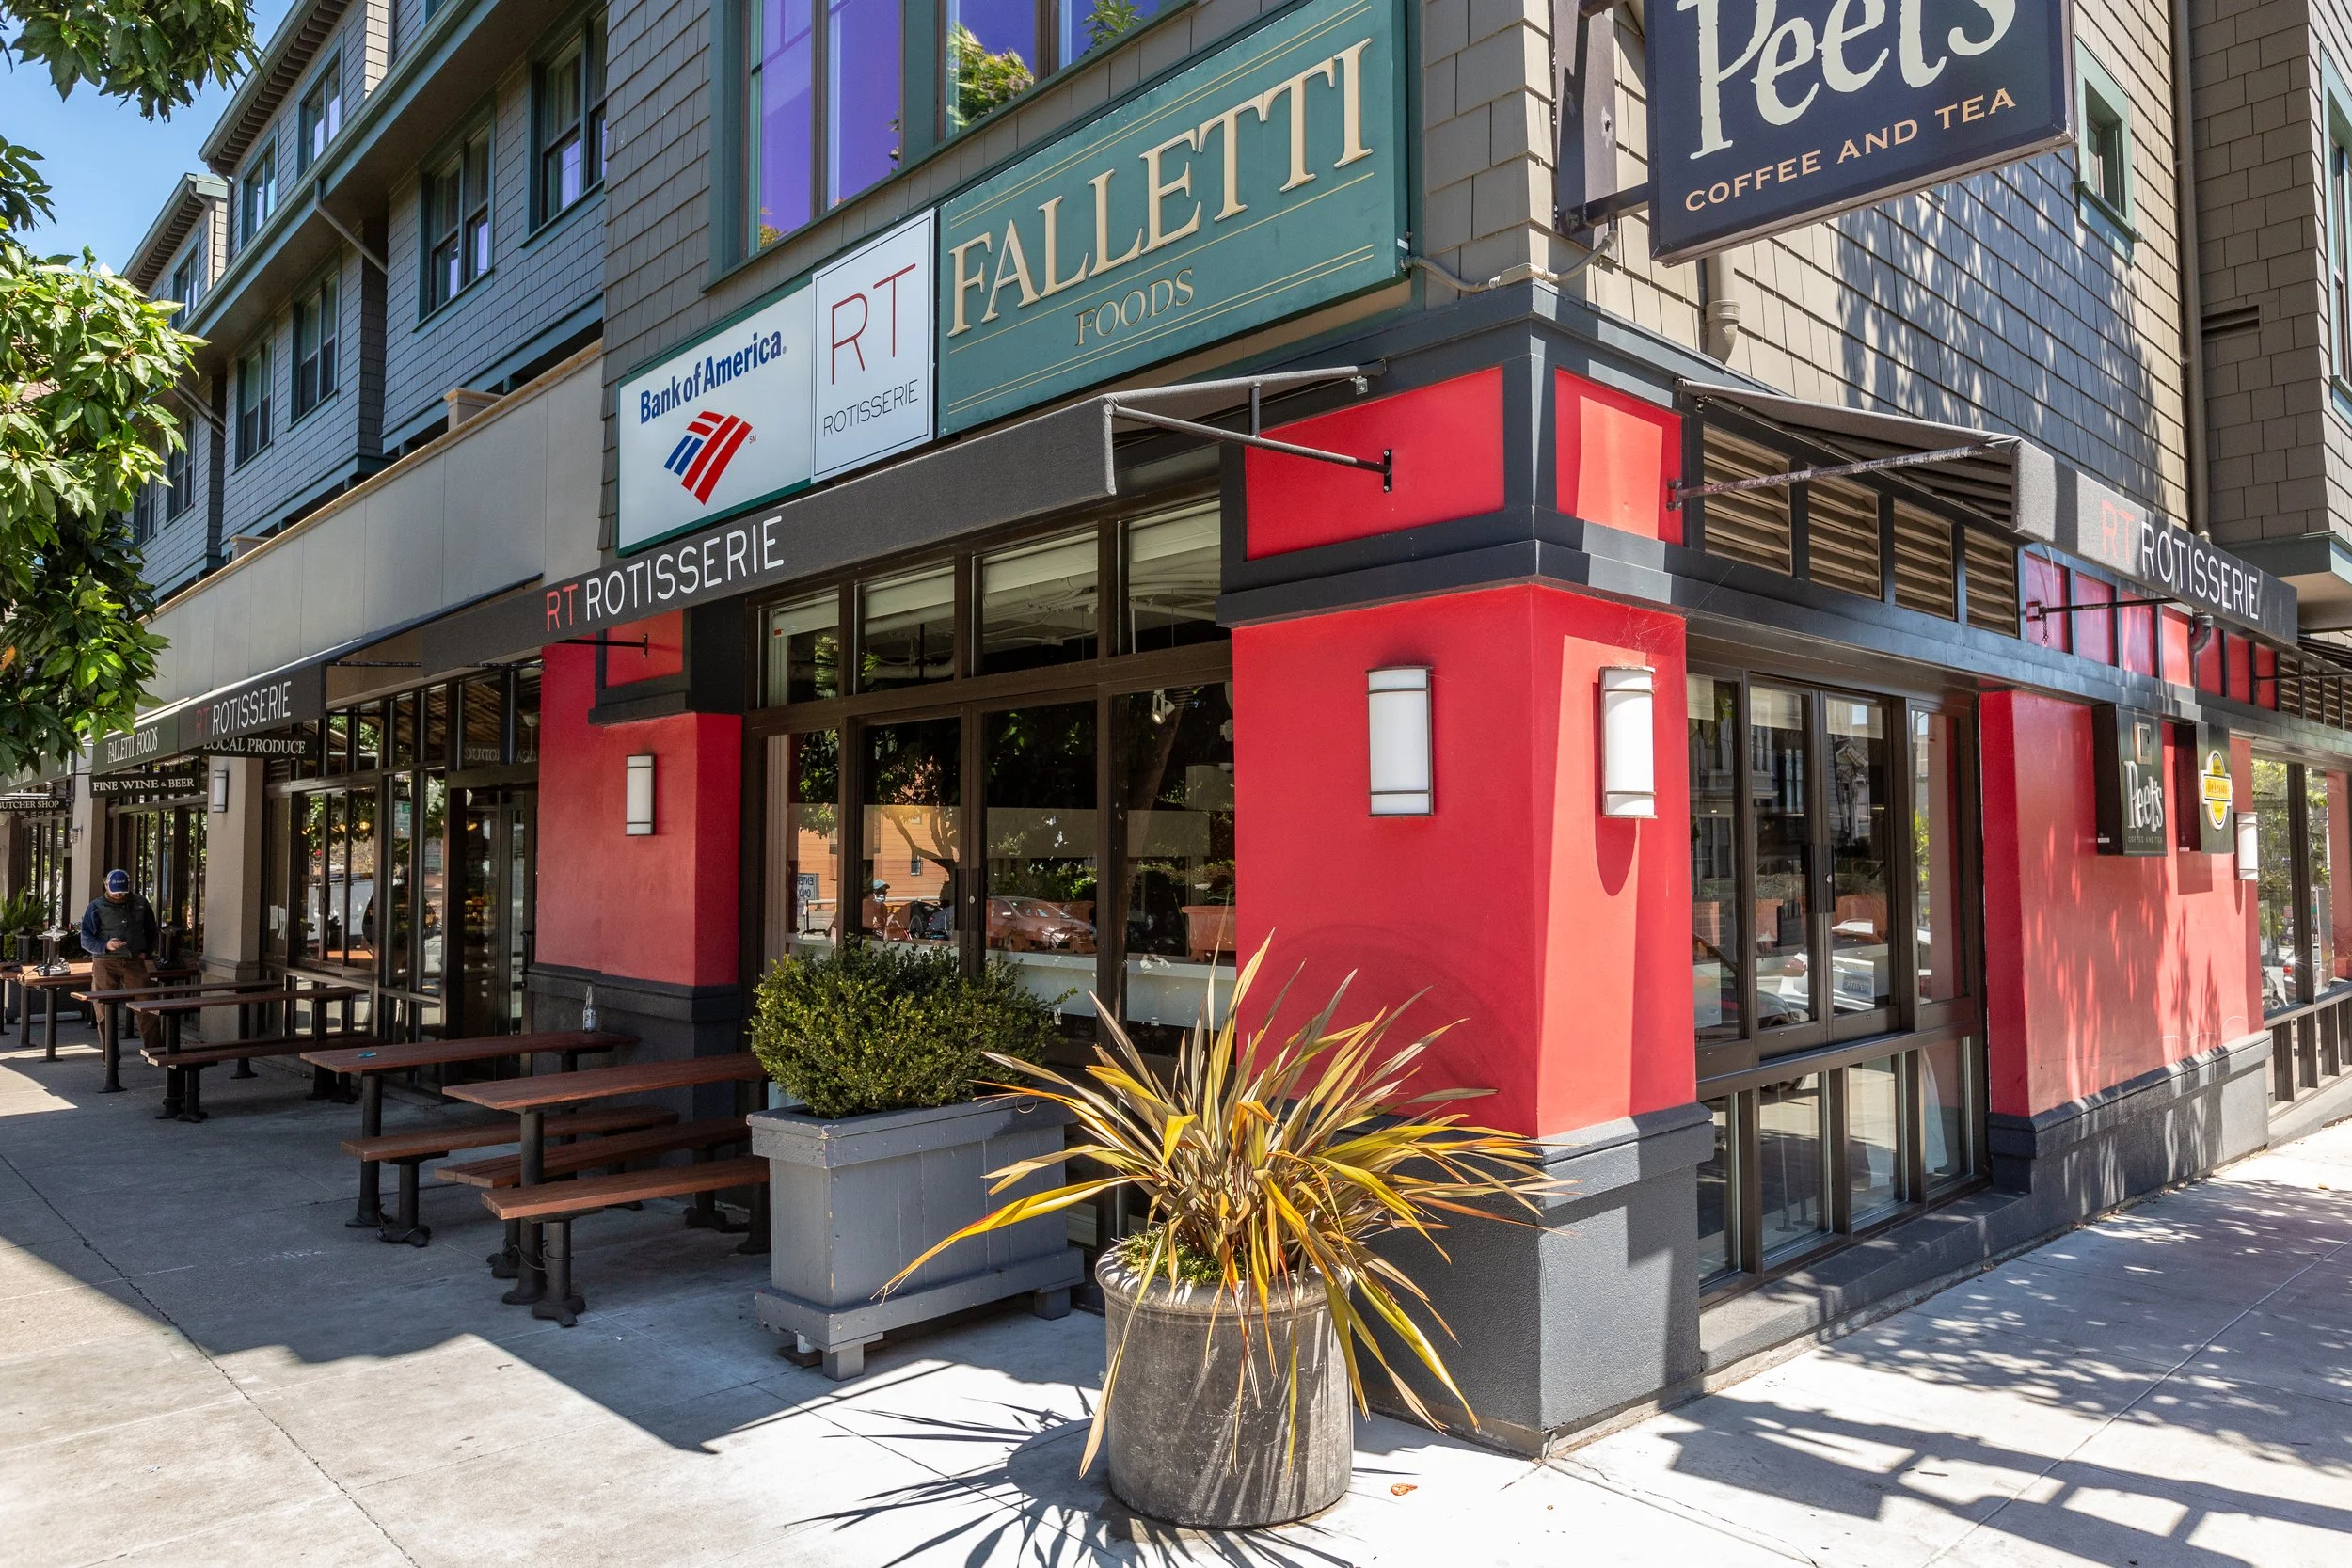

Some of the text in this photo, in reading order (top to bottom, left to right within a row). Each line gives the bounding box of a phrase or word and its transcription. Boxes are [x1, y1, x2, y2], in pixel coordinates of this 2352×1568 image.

[1684, 87, 2017, 212] COFFEE AND TEA
[947, 38, 1374, 338] FALLETTI
[831, 263, 916, 385] RT
[1074, 267, 1195, 345] FOODS
[641, 376, 681, 424] Bank
[683, 361, 701, 402] of
[822, 379, 919, 437] ROTISSERIE
[547, 515, 785, 632] RT ROTISSERIE
[2102, 499, 2259, 621] RT ROTISSERIE
[195, 680, 292, 739] RT ROTISSERIE
[107, 726, 158, 764] FALLETTI FOODS
[247, 738, 306, 754] PRODUCE
[37, 800, 59, 809] SHOP
[92, 781, 119, 791] FINE
[120, 779, 159, 790] WINE
[167, 778, 195, 788] BEER
[2123, 760, 2163, 832] Peet's
